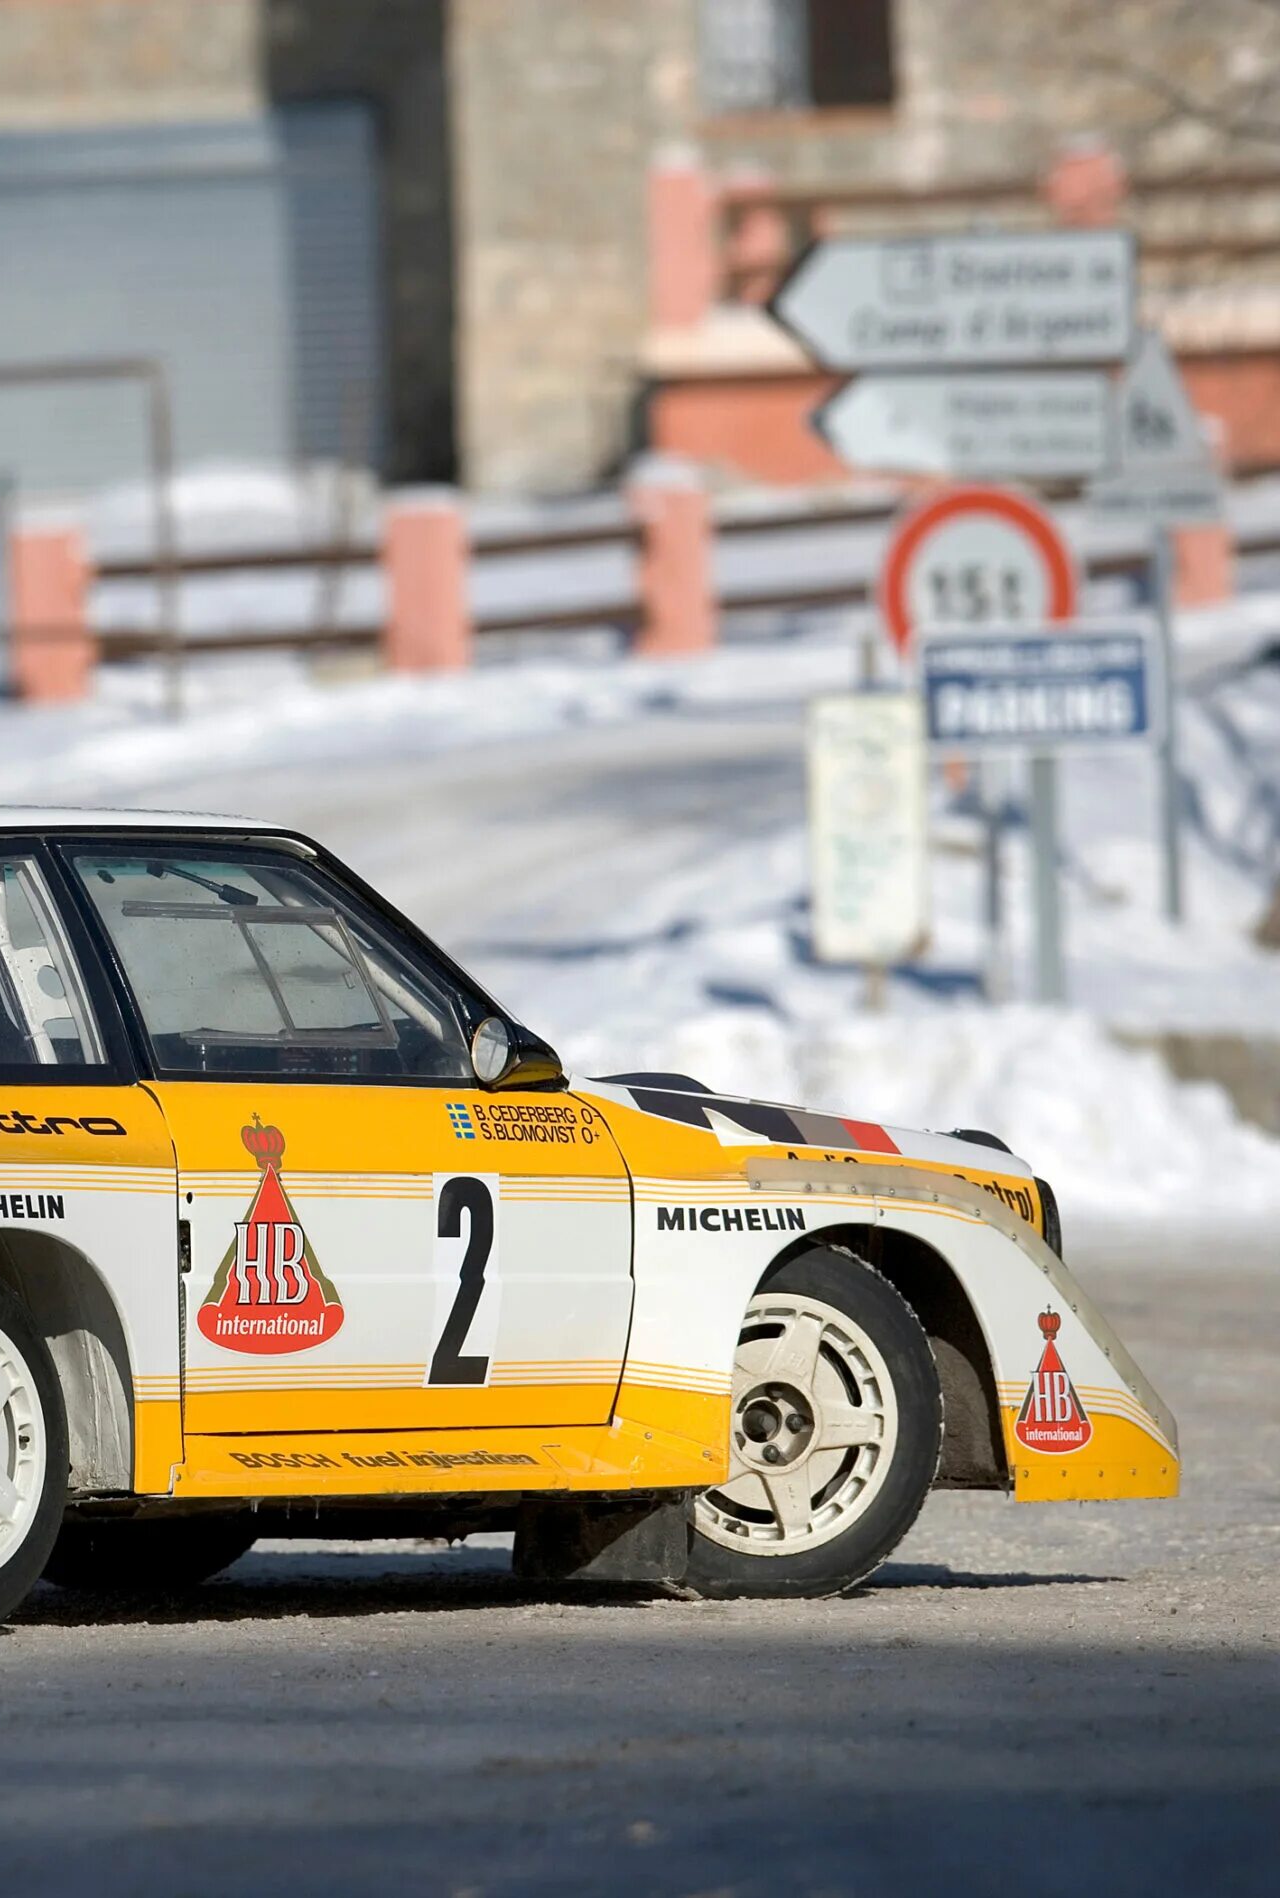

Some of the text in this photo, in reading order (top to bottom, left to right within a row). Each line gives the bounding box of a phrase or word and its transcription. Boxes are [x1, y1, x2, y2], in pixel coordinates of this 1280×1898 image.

[657, 1207, 807, 1231] MICHELIN
[234, 1222, 310, 1305] HB
[428, 1176, 494, 1384] 2
[216, 1312, 325, 1336] international
[1030, 1371, 1073, 1422] HB
[1025, 1427, 1083, 1441] international
[229, 1450, 540, 1469] BOSCH fuel injection
